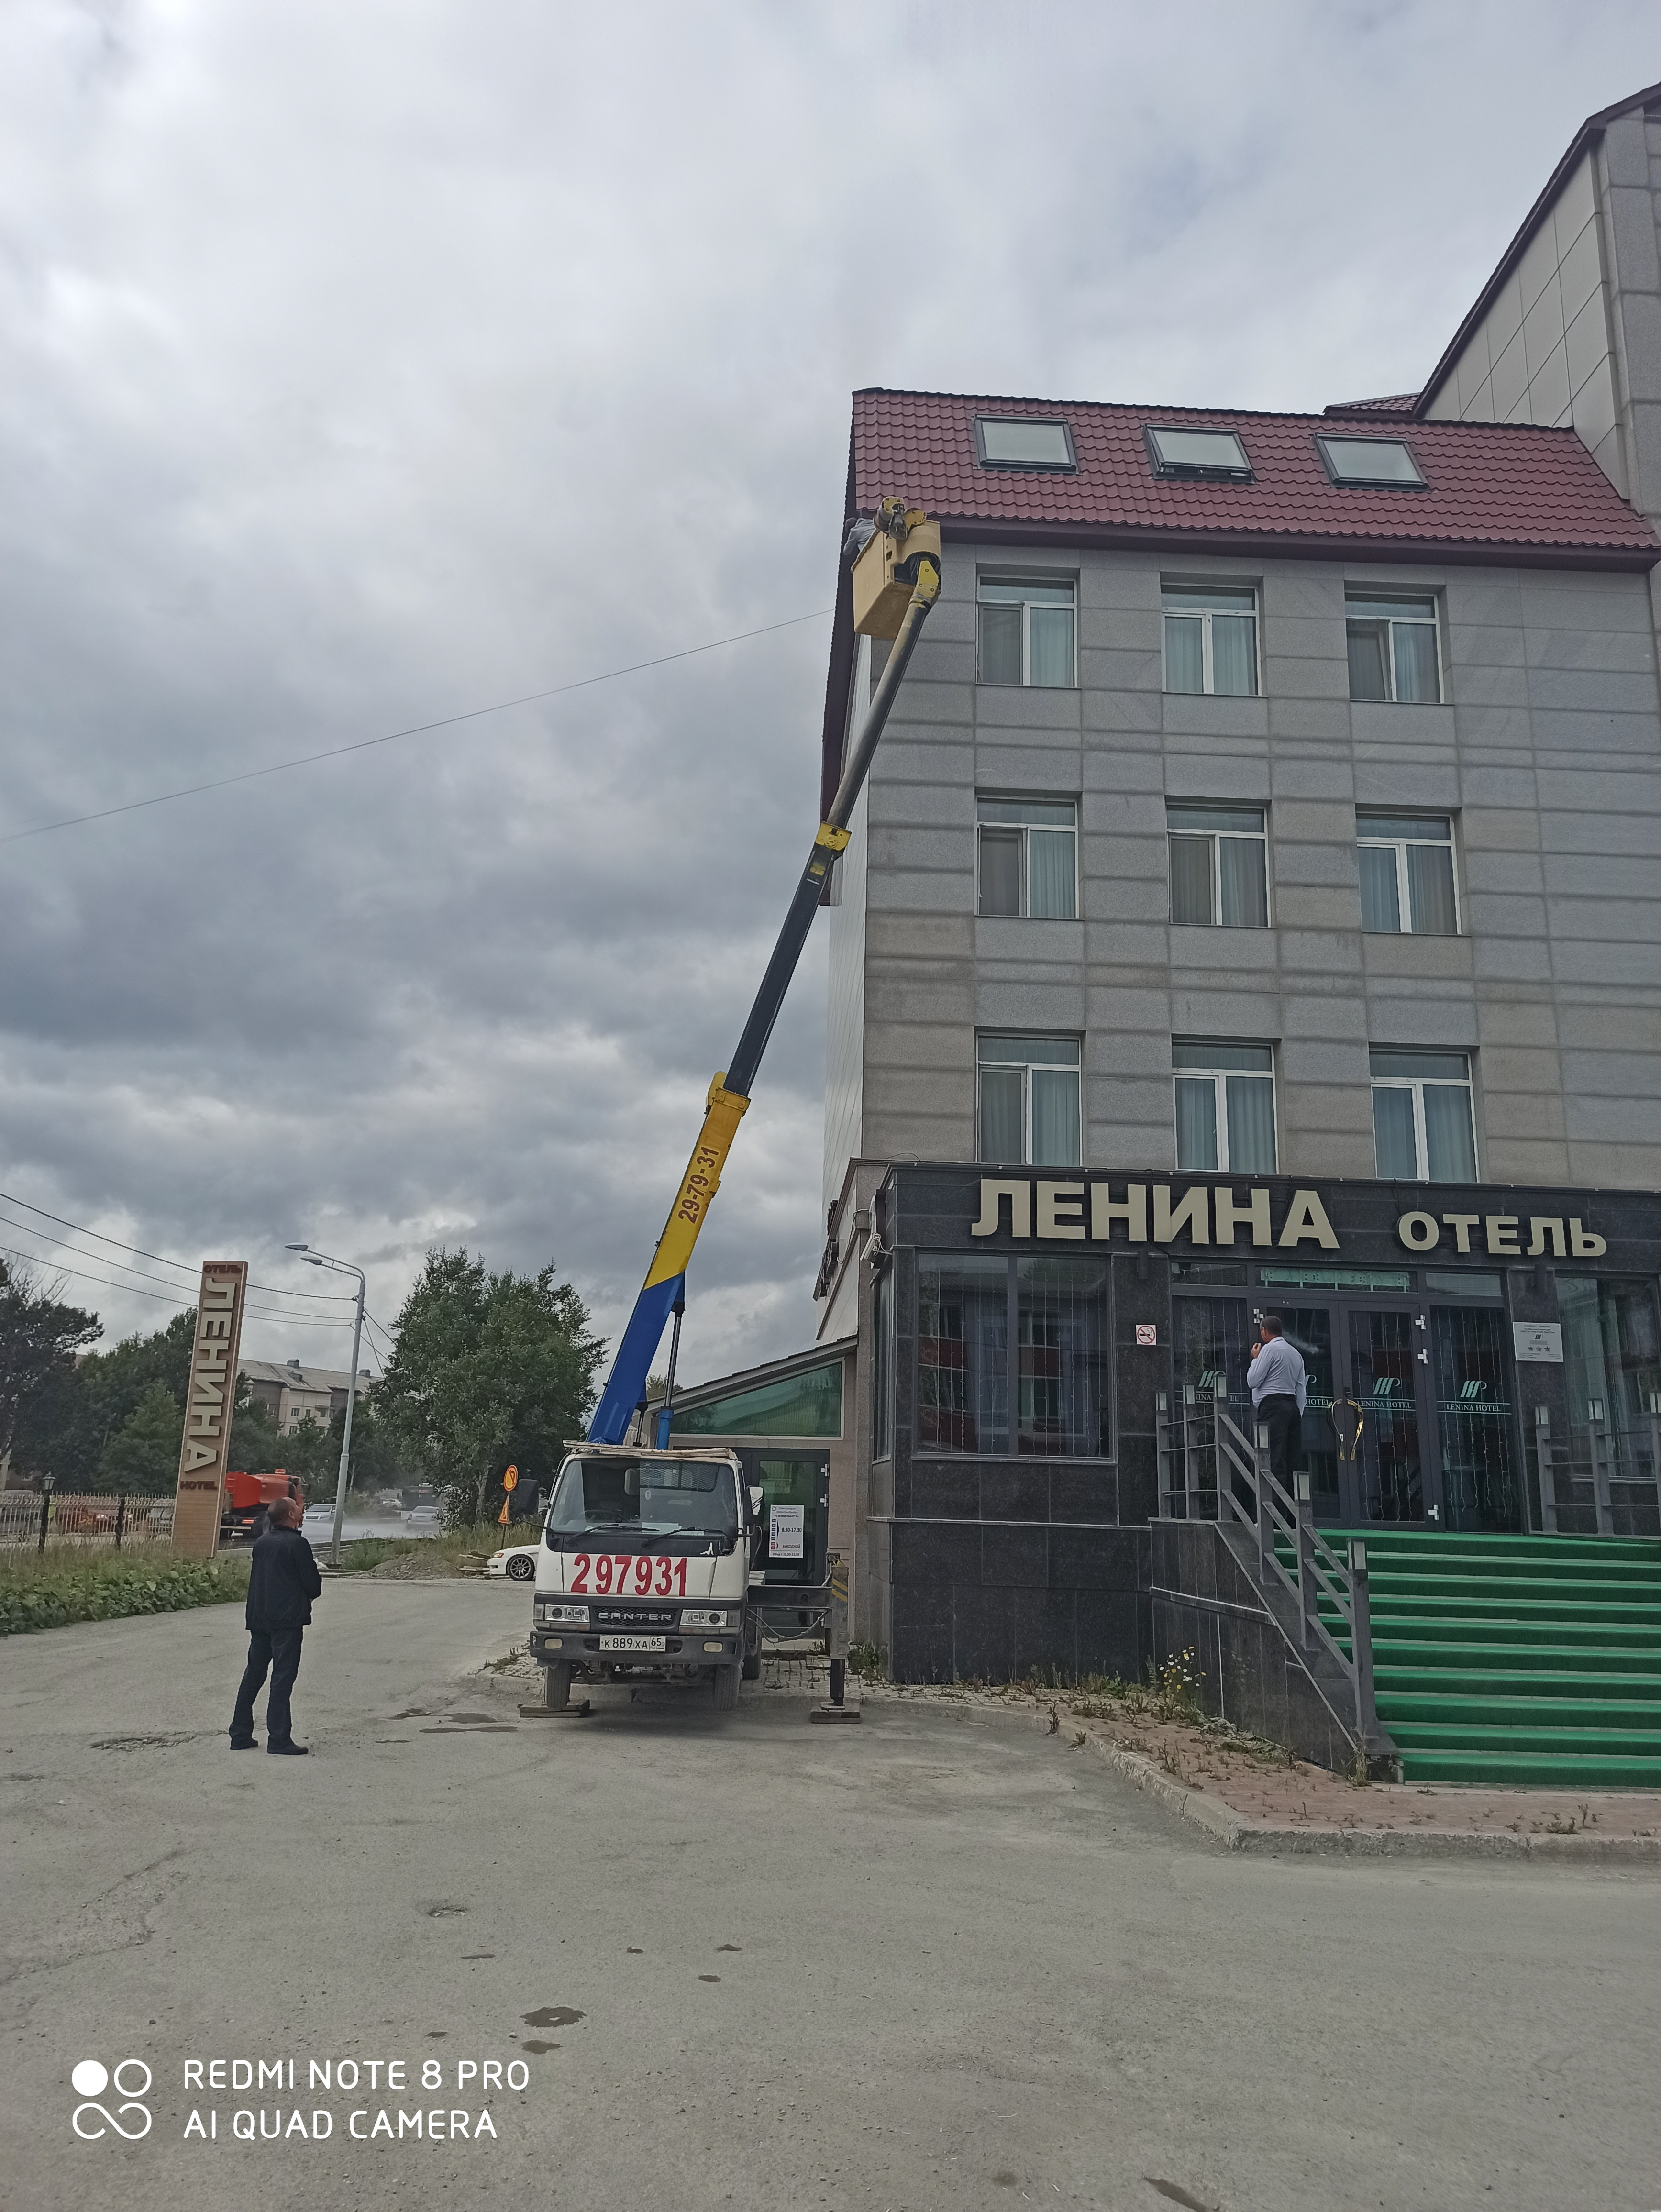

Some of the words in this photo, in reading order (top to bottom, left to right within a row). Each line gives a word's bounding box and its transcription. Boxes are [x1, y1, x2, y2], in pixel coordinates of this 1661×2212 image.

[678, 1147, 719, 1224] 29-79-31
[971, 1179, 1340, 1249] ЛЕНИНА
[1397, 1211, 1607, 1257] ОТЕЛЬ
[203, 1264, 242, 1273] ОТЕЛЬ
[184, 1277, 236, 1472] ЛЕНИНА
[1357, 1400, 1384, 1408] LENINA
[180, 1481, 218, 1490] HOTEL
[570, 1553, 687, 1597] 297931
[598, 1612, 672, 1621] CANTER
[651, 1638, 662, 1647] 65
